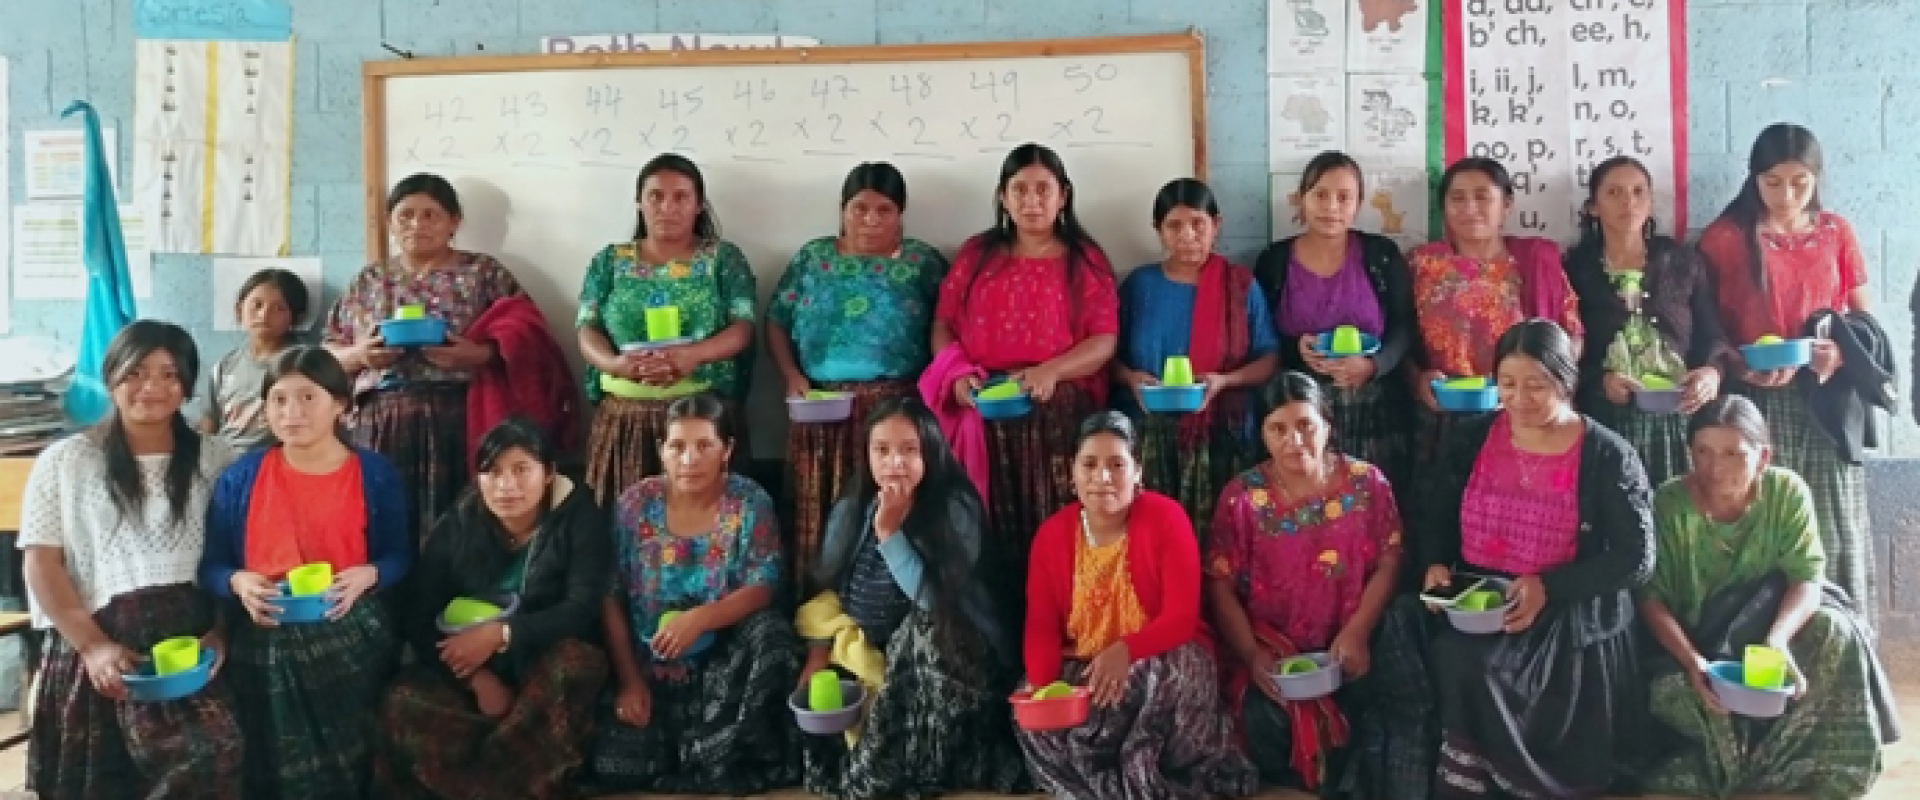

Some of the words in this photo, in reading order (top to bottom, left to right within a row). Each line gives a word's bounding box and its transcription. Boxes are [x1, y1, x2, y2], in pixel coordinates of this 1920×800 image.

[1505, 18, 1547, 48] ch,
[1569, 21, 1614, 45] ee,
[1623, 13, 1651, 42] h,
[1469, 68, 1487, 98] i,
[1494, 66, 1519, 96] ii,
[1526, 66, 1546, 97] j,
[1597, 65, 1637, 90] m,
[424, 94, 476, 131] 42
[500, 89, 548, 129] 43
[585, 84, 623, 118] 44
[658, 85, 703, 122] 45
[733, 77, 776, 112] 46
[810, 74, 859, 109] 47
[889, 71, 931, 107] 48
[969, 69, 1019, 112] 49
[1063, 63, 1118, 94] 50
[1574, 99, 1601, 123] n,
[1608, 98, 1638, 123] o,
[1471, 98, 1499, 129] k,
[1508, 96, 1546, 126] k',
[1527, 138, 1556, 166] p,
[1574, 138, 1596, 159] r,
[1631, 129, 1654, 157] t,
[1519, 210, 1547, 232] u,
